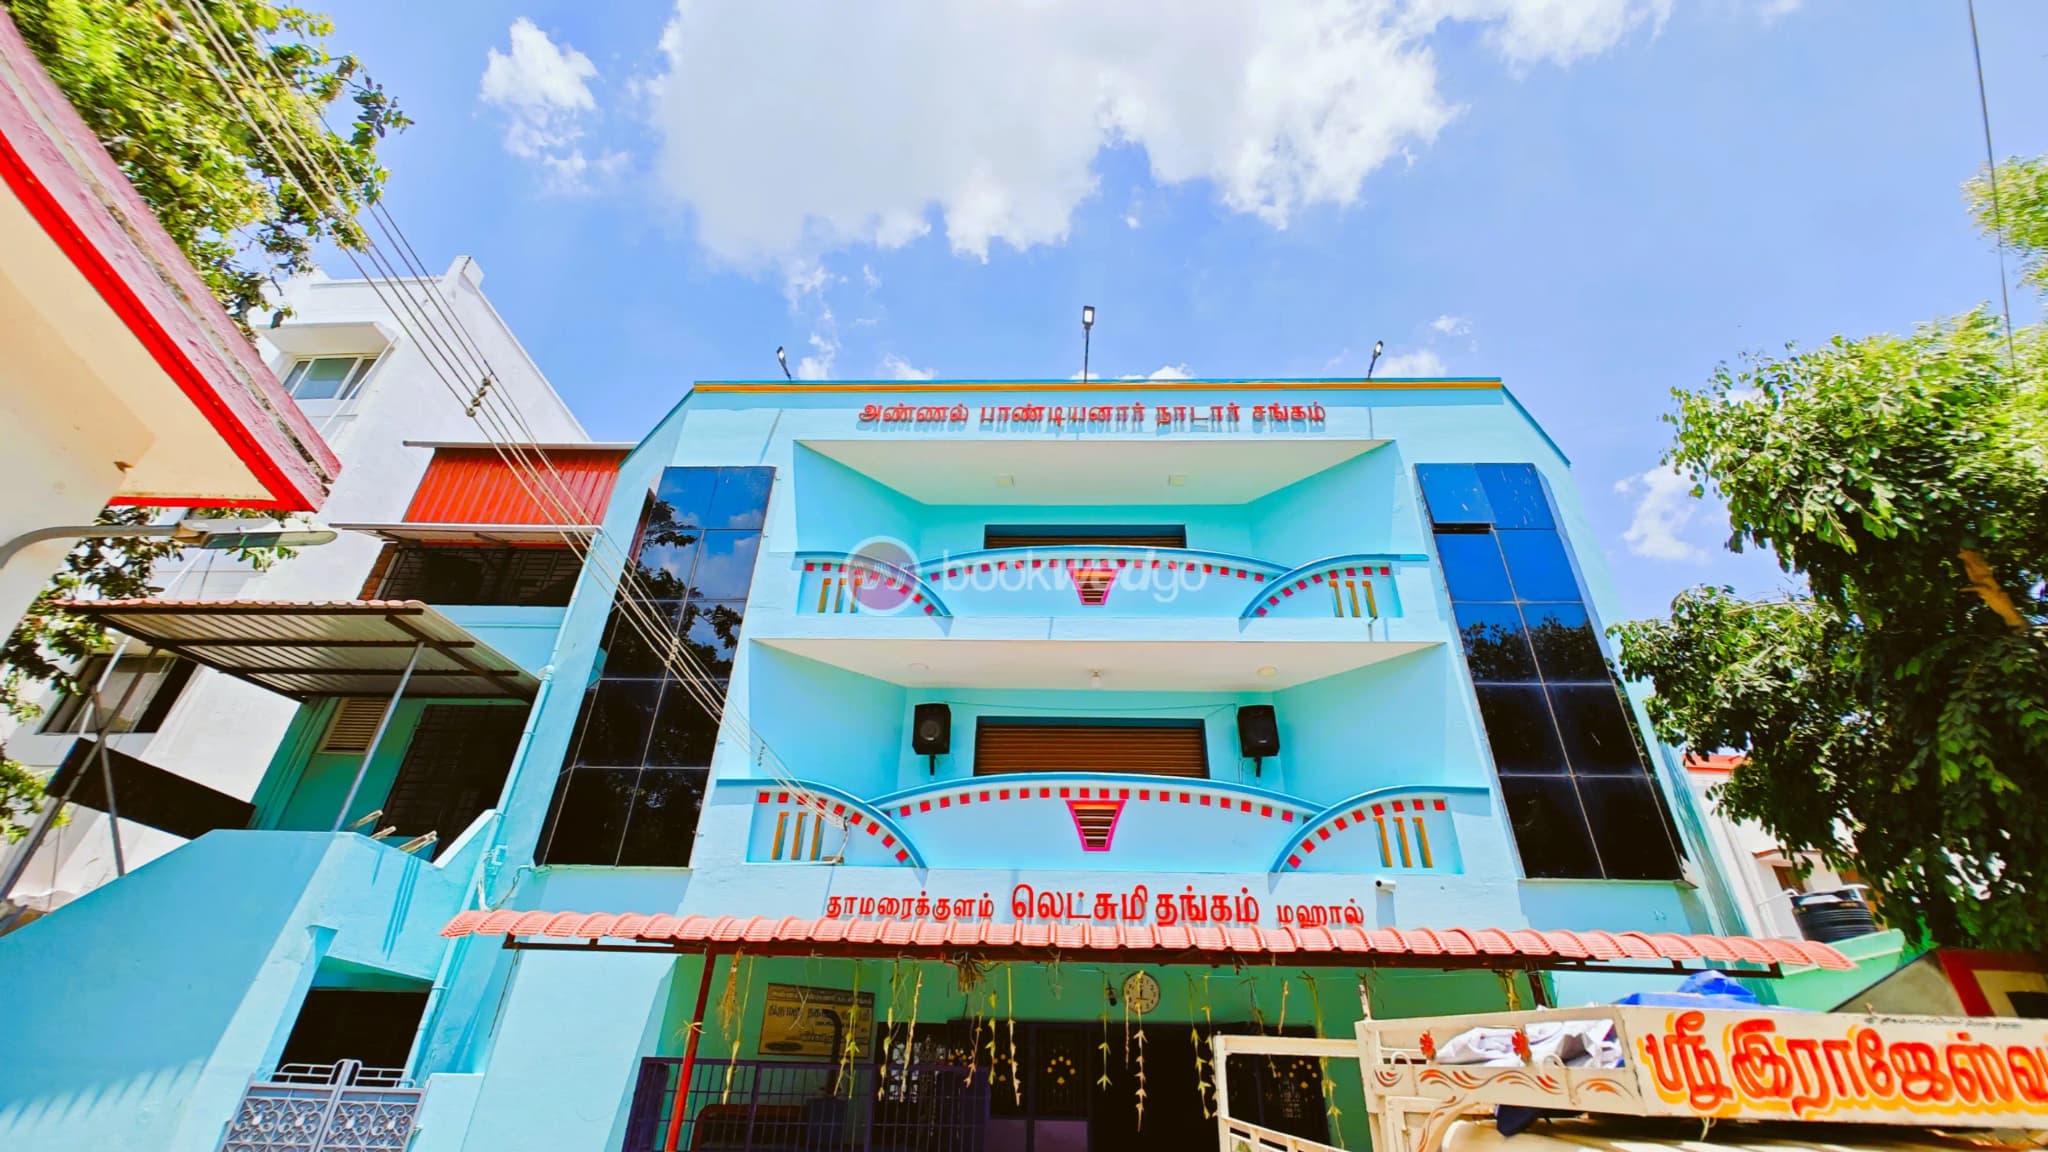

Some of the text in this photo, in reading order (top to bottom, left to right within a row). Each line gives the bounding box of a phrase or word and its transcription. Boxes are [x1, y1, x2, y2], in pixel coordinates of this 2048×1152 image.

[858, 402, 1326, 427] அண்ணல் பாண்டியனார் நாடார் சங்கம்
[826, 883, 1364, 928] தாமரைக்குளம் லெட்சுமி தங்கம் மஹால்
